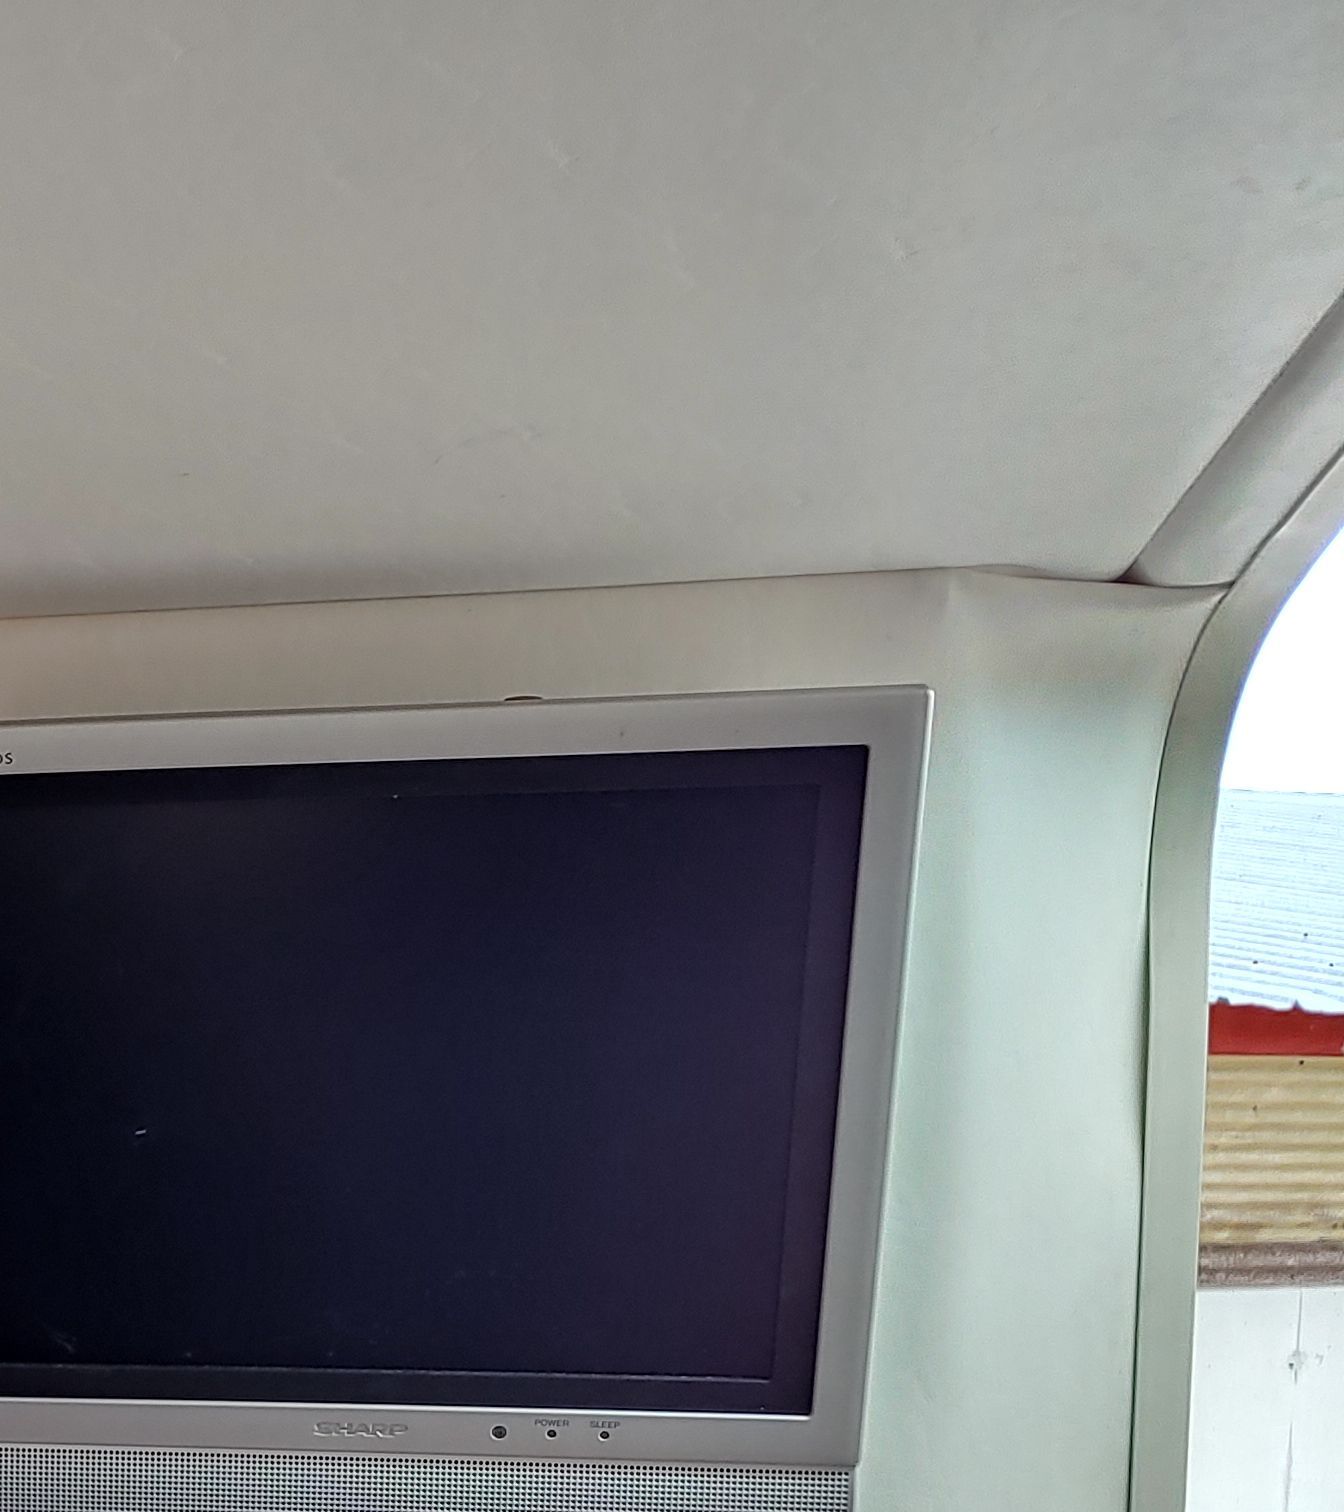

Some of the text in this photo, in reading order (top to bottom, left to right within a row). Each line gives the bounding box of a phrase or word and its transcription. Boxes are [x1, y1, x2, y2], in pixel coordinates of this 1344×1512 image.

[534, 1419, 570, 1428] POWER
[589, 1420, 621, 1429] SLEEP
[312, 1420, 409, 1438] SHARP
